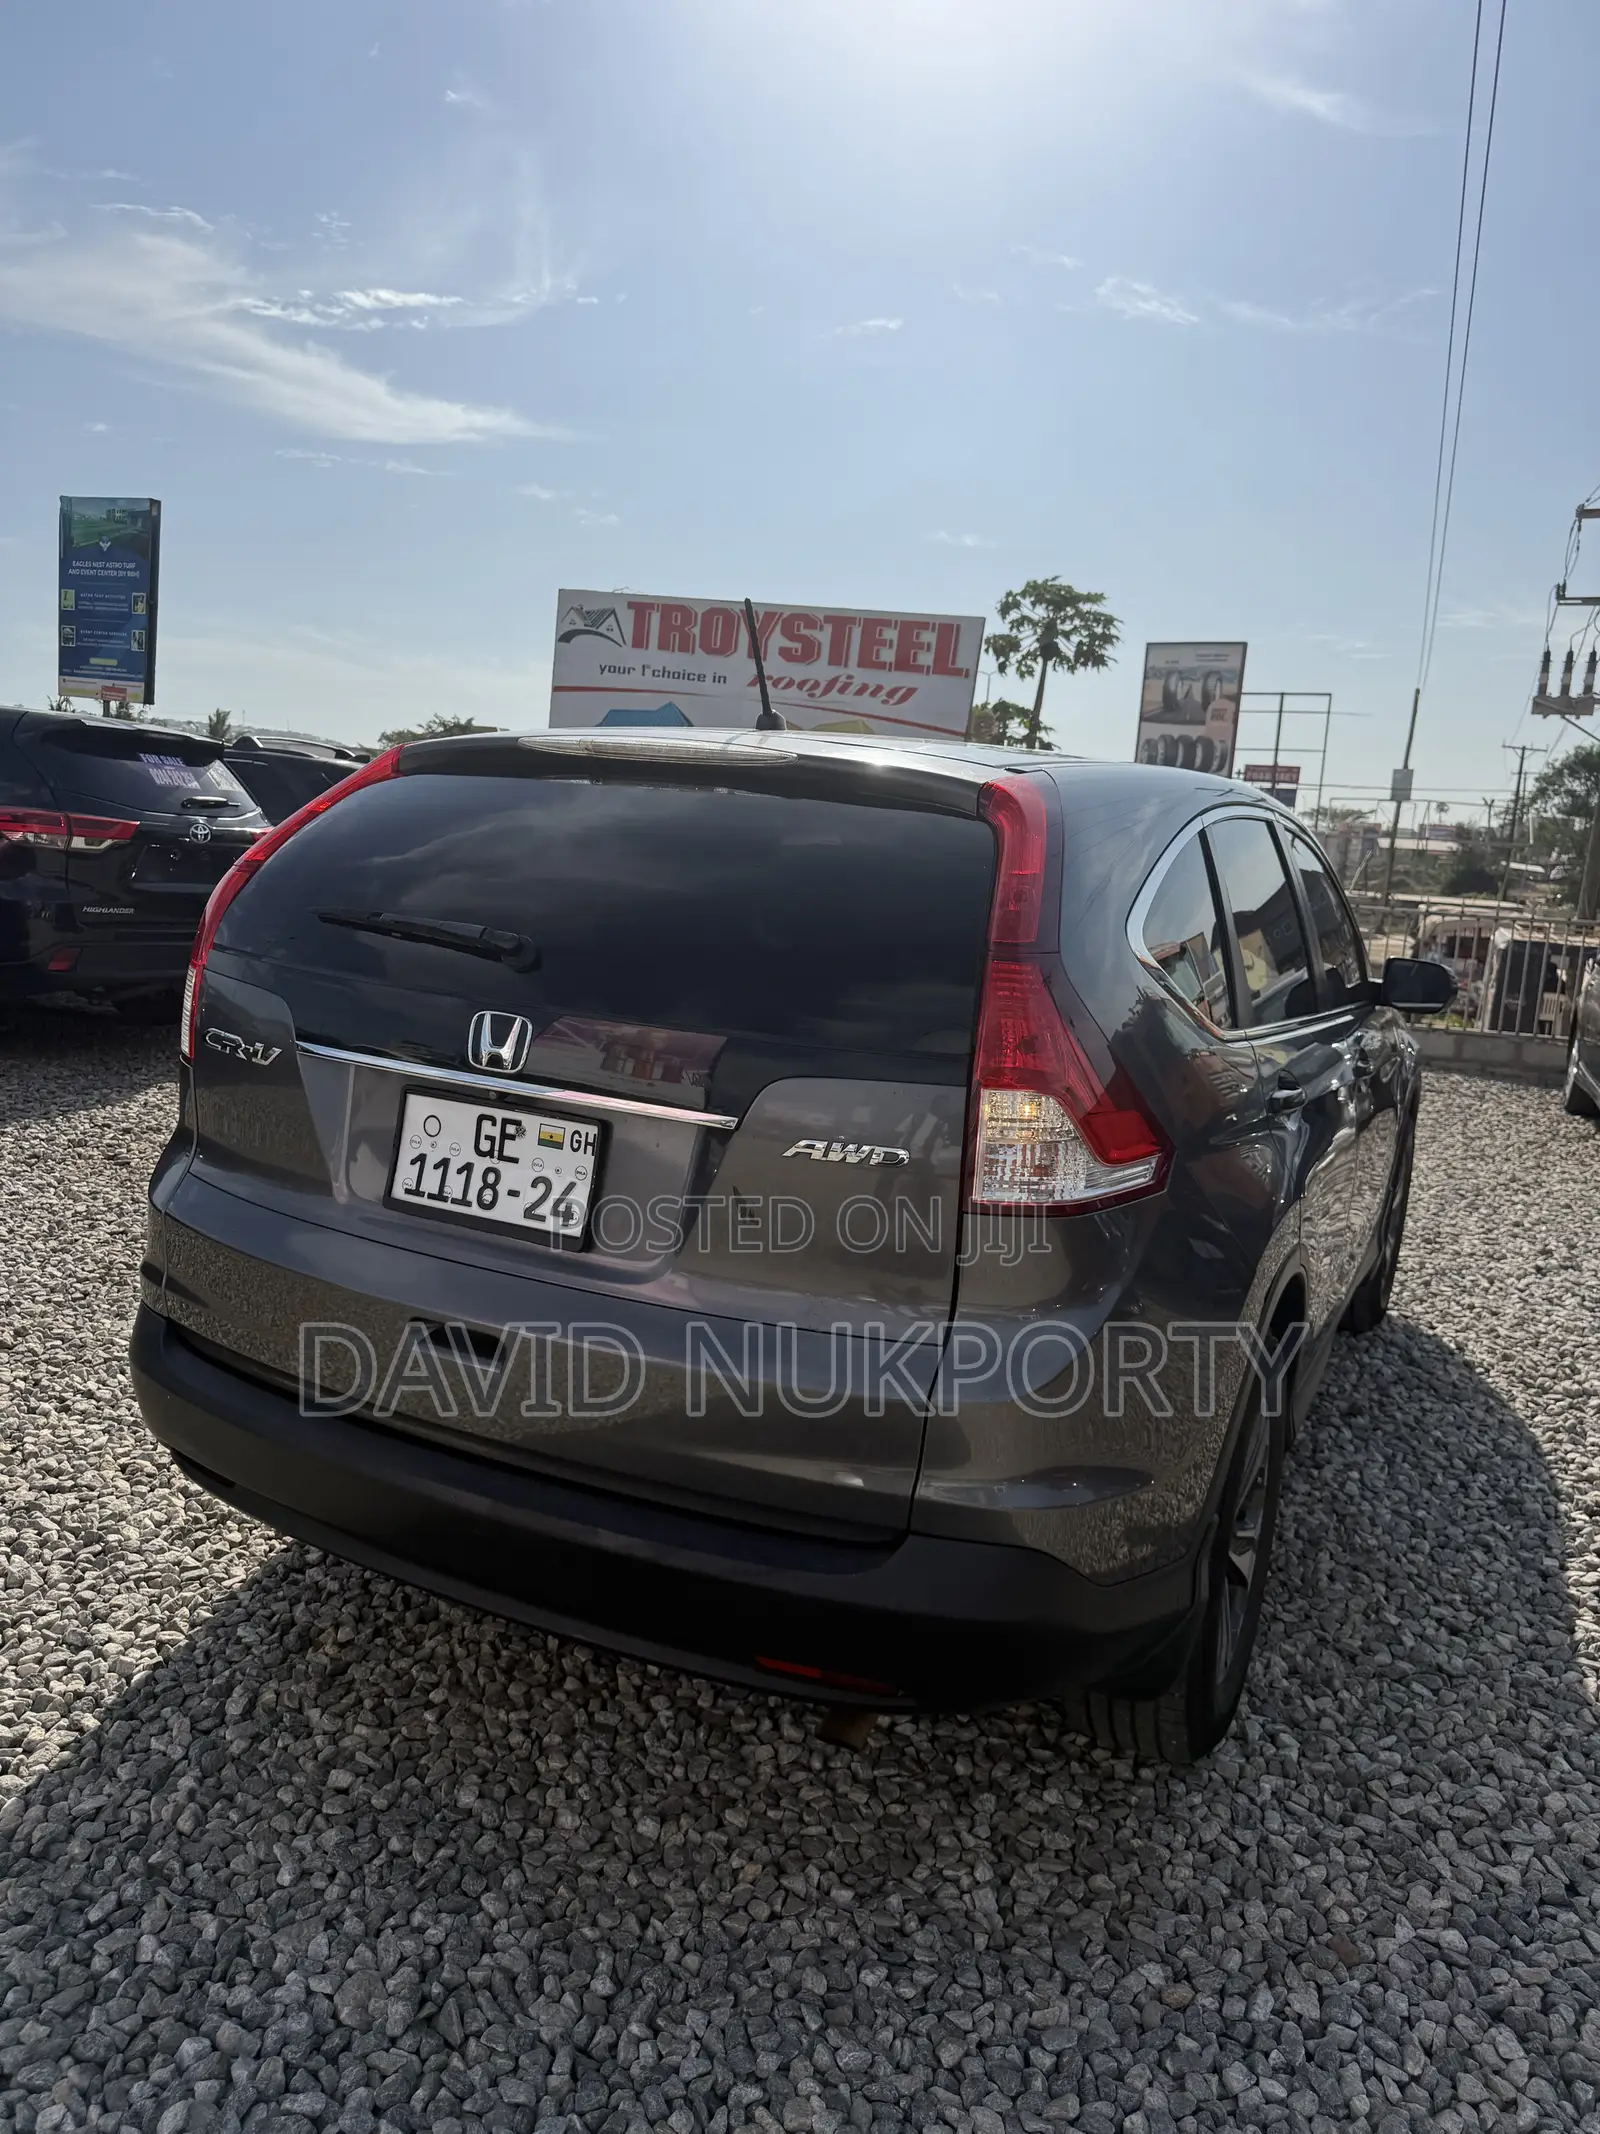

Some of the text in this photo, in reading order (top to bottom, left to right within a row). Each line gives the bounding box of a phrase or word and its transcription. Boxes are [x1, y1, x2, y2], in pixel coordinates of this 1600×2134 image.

[626, 600, 970, 678] TROYSTEEL
[599, 664, 636, 675] your
[651, 665, 706, 683] choice
[712, 672, 727, 684] in
[747, 672, 918, 706] roofing
[140, 753, 186, 767] FOR SALE
[82, 905, 135, 914] HIGHLANDER
[204, 1027, 283, 1066] CR-V
[474, 1113, 522, 1164] GE
[570, 1130, 597, 1156] GH
[781, 1139, 911, 1167] AWD
[404, 1152, 577, 1227] 1118-24
